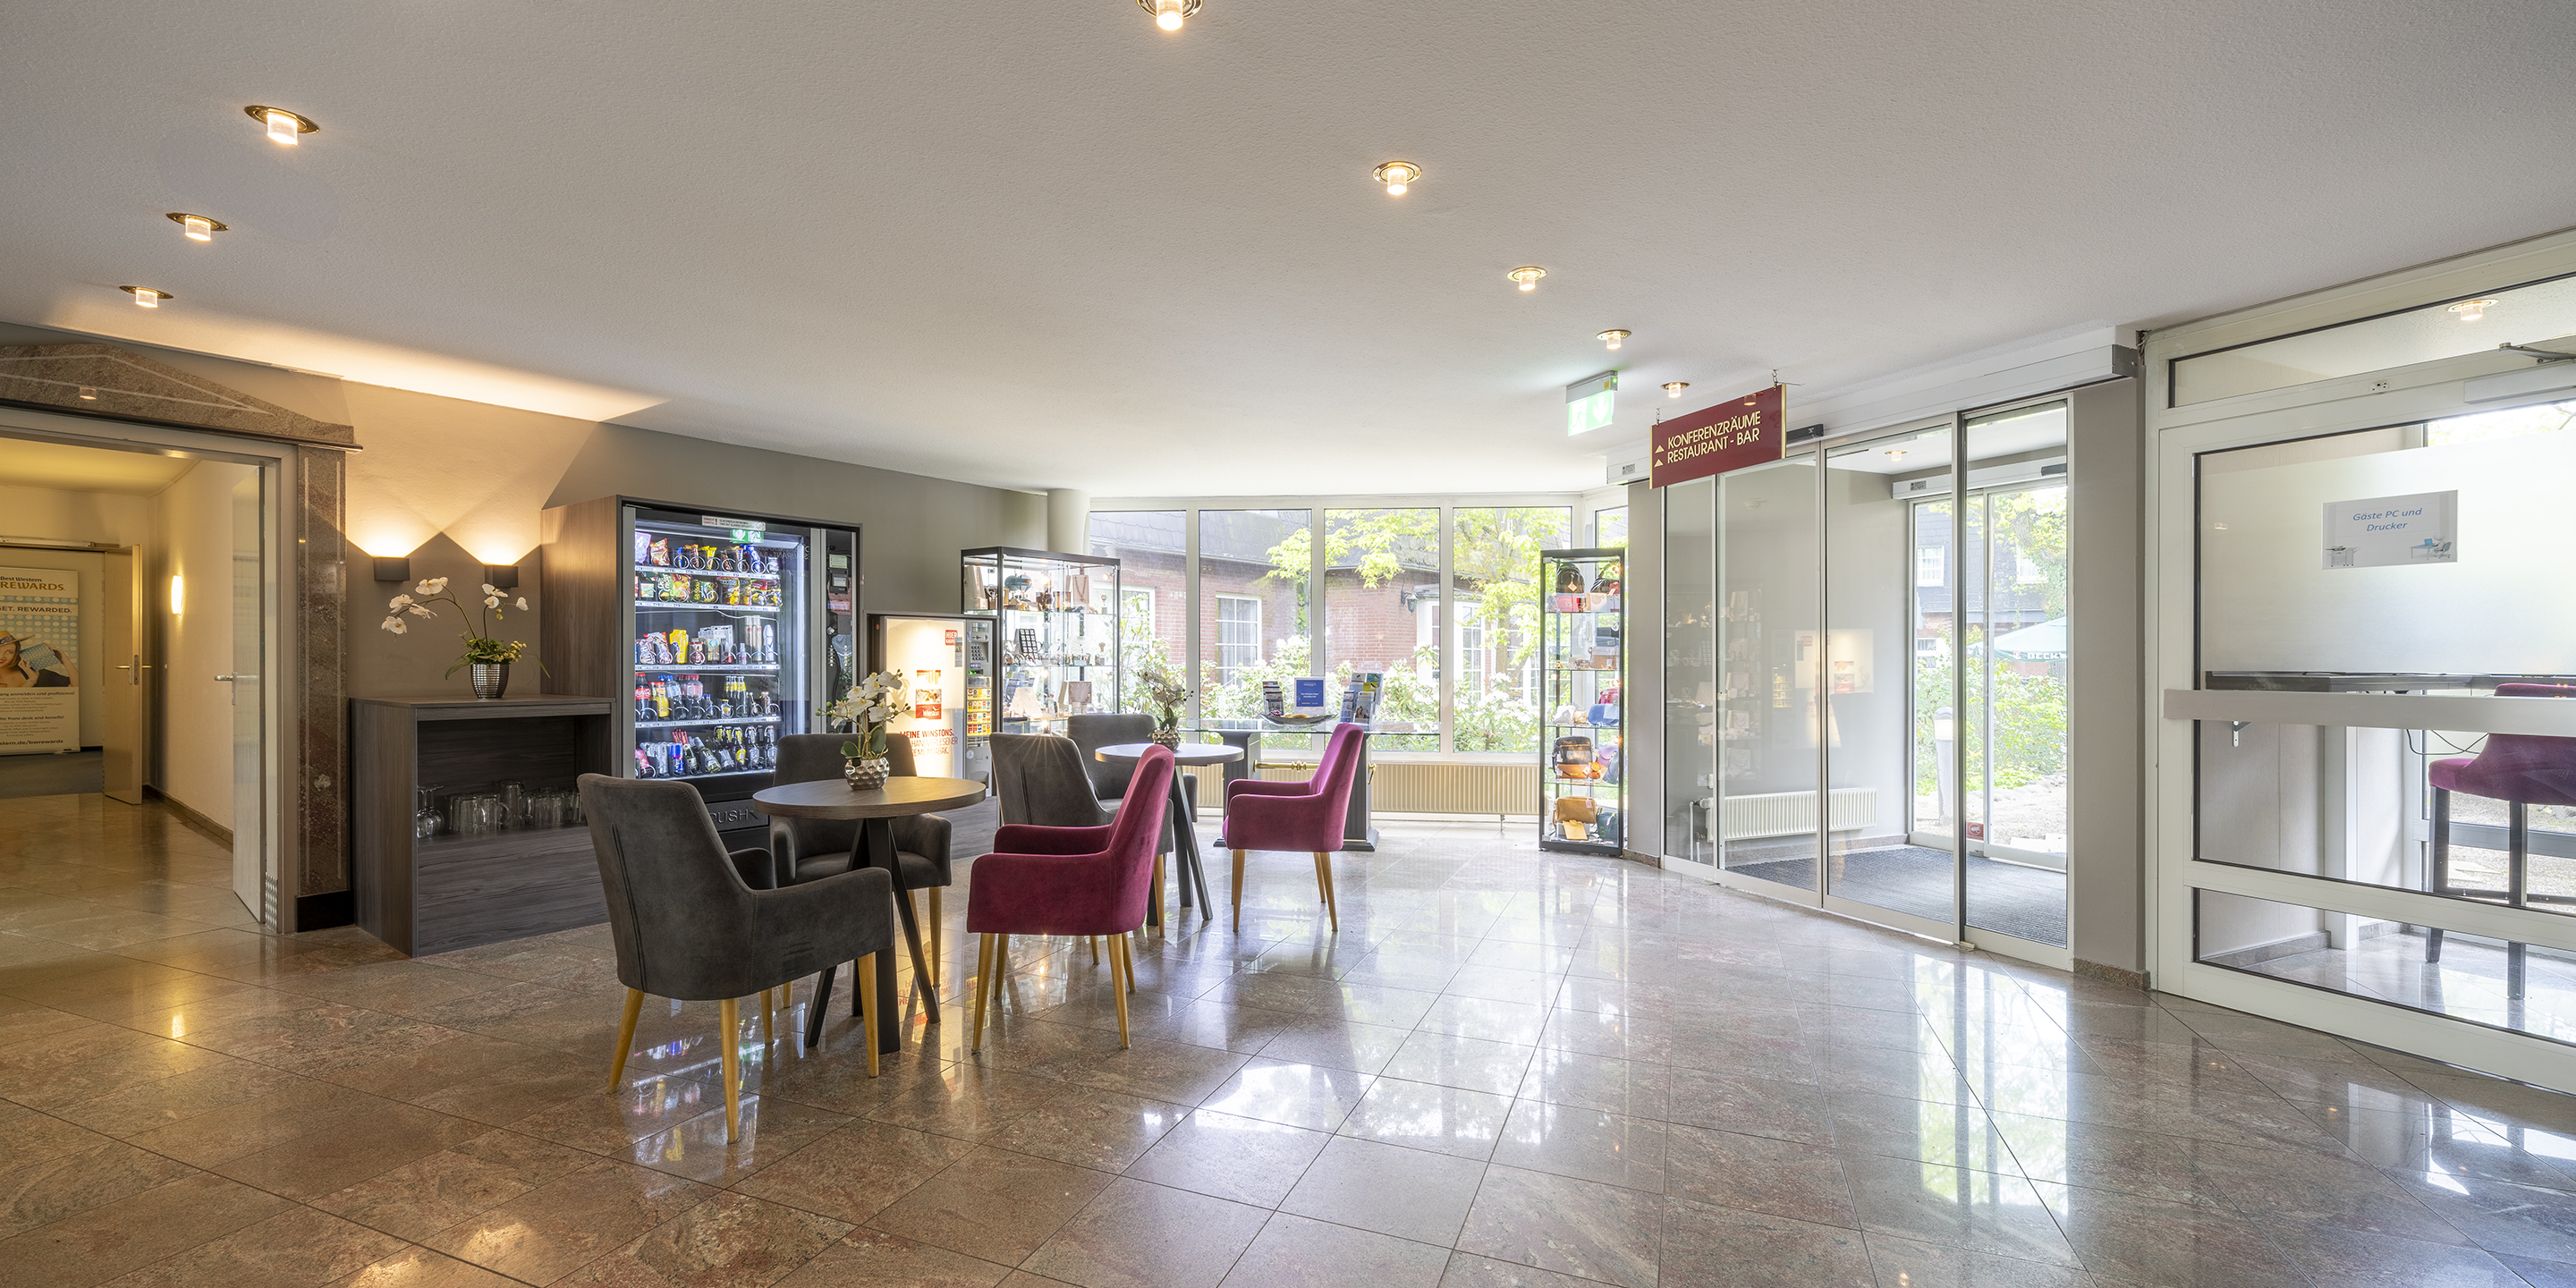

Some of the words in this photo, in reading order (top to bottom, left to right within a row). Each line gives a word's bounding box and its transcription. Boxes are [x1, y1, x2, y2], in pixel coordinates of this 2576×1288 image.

[1667, 411, 1761, 450] KONFERENZRÄUME
[1667, 436, 1729, 464] RESTAURANT
[1737, 428, 1760, 445] BAR
[2352, 513, 2382, 521] Gäste
[2385, 510, 2399, 518] PC
[2402, 508, 2423, 516] und
[2367, 522, 2408, 531] Drucker
[0, 581, 66, 591] REWARDS.
